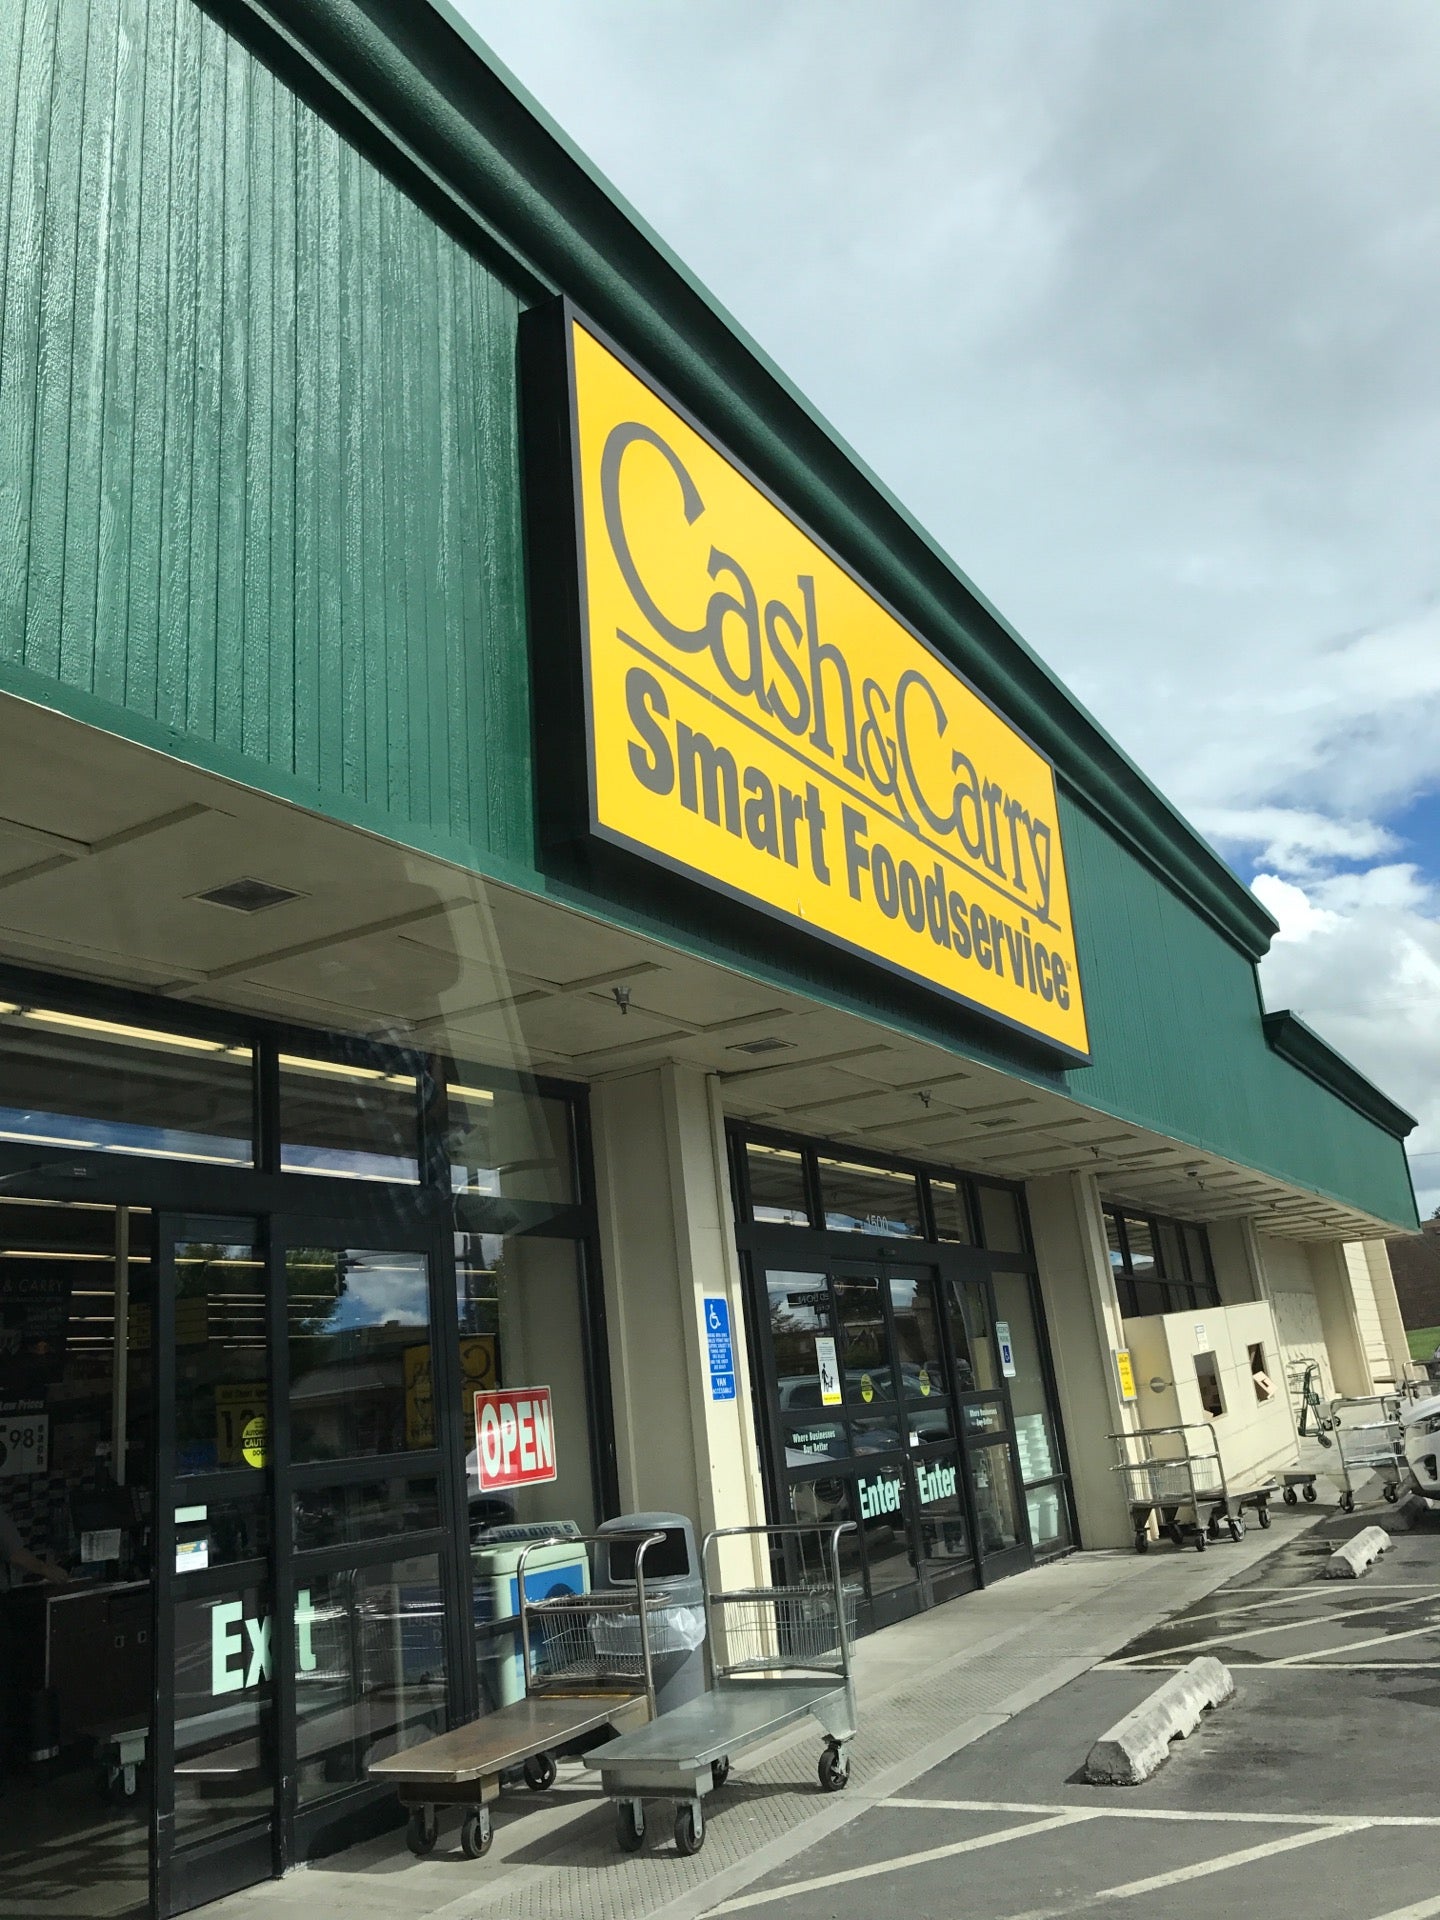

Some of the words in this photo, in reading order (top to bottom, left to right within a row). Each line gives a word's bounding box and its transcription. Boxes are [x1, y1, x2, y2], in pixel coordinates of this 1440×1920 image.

[625, 667, 831, 886] Smart
[841, 802, 1070, 1011] Foodservice
[716, 1377, 727, 1386] VAN
[481, 1400, 552, 1477] OPEN
[792, 1433, 809, 1443] Where
[809, 1430, 836, 1441] Businesses
[858, 1475, 901, 1519] Enter
[917, 1464, 956, 1504] Enter
[212, 1589, 317, 1696] Ext
